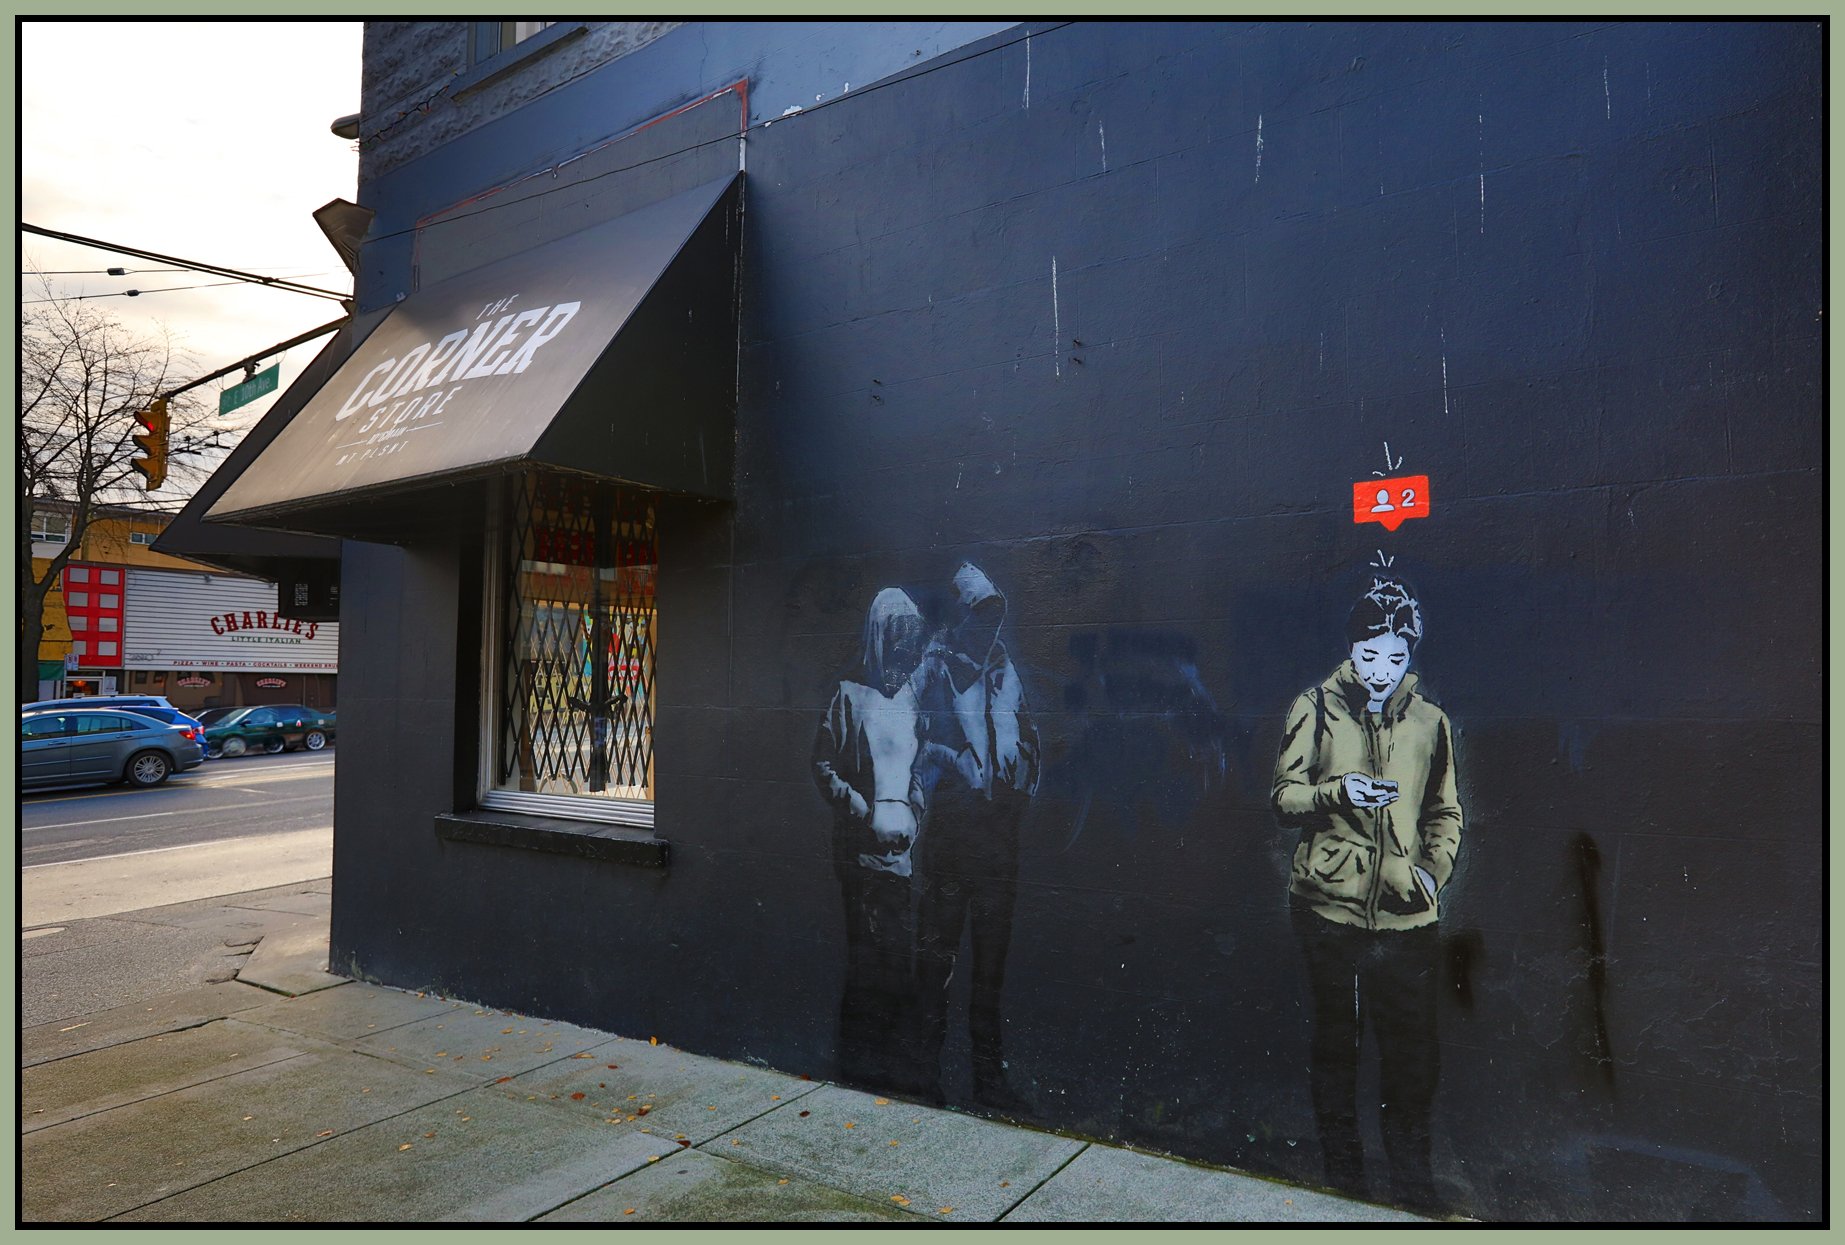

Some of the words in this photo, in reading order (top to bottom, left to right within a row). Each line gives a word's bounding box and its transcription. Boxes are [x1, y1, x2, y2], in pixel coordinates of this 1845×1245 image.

[477, 293, 519, 320] THE
[335, 301, 581, 421] CORNER
[359, 386, 463, 433] STORE
[1401, 489, 1415, 507] 2
[211, 611, 319, 640] CHARLIES
[265, 637, 302, 645] ITALIAN
